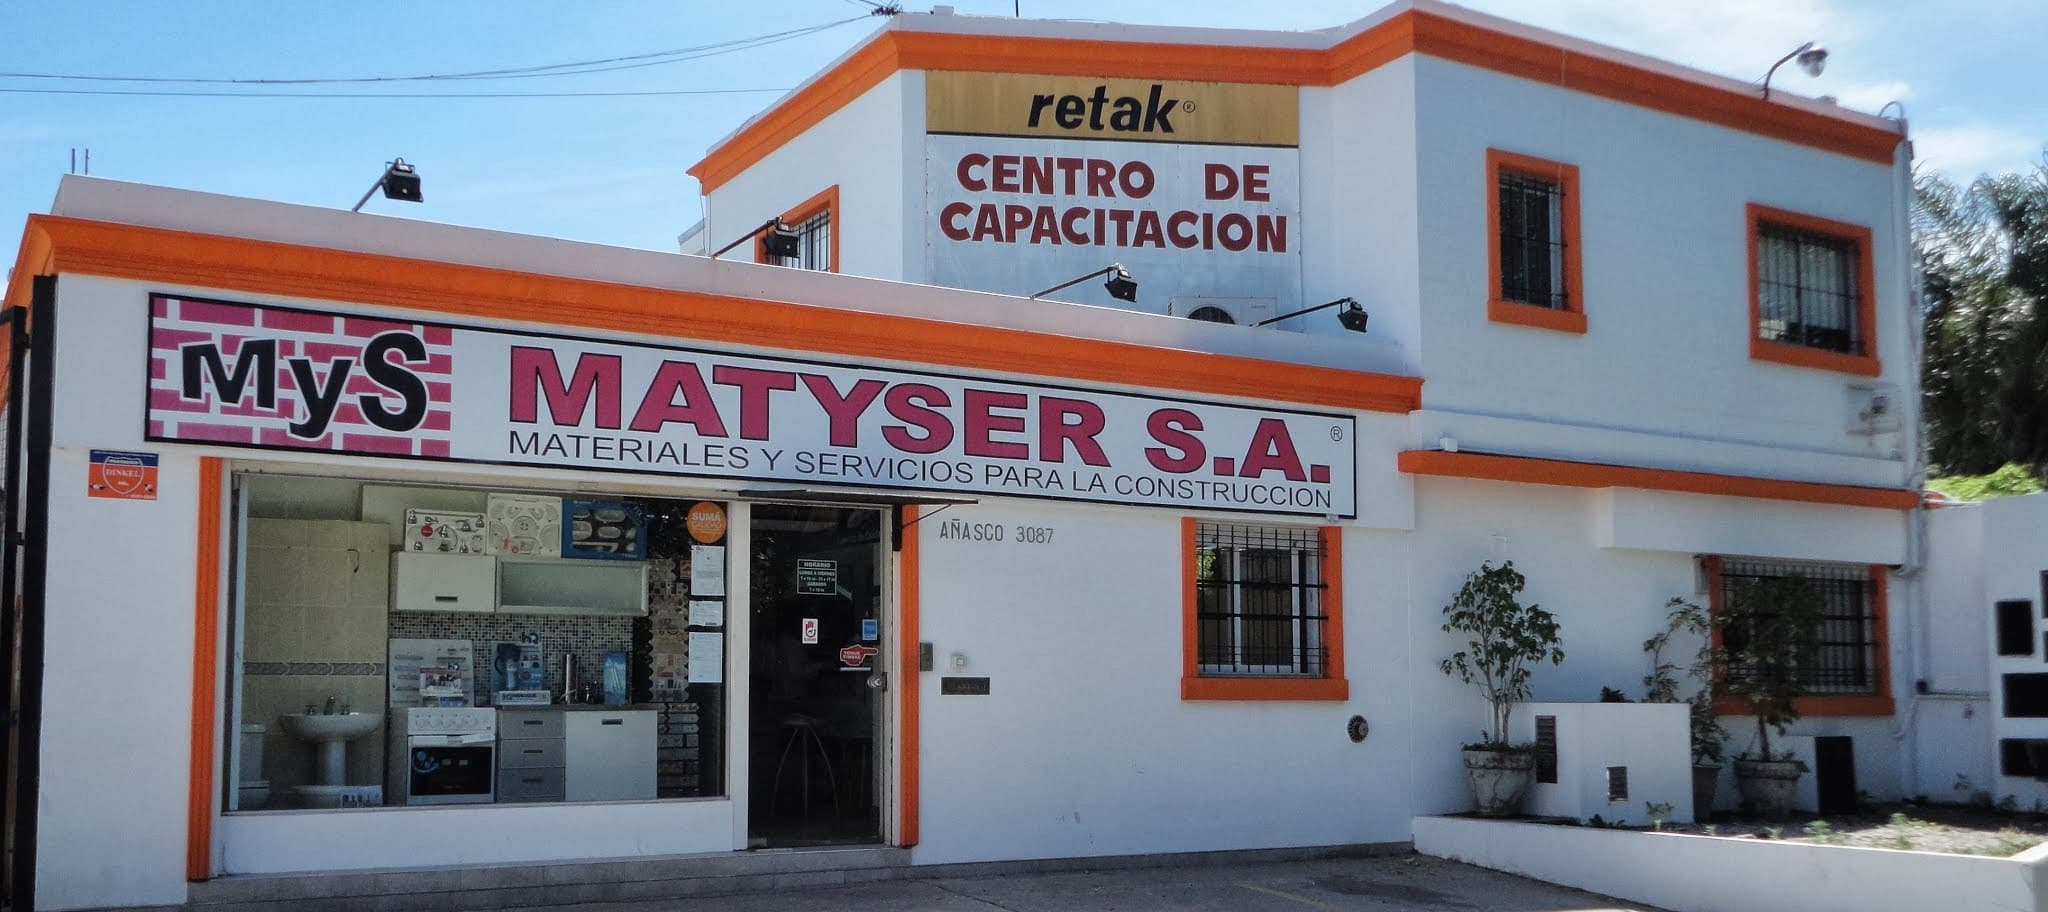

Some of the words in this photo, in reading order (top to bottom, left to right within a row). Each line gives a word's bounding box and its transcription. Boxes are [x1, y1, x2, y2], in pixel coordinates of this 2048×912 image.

[1028, 84, 1179, 134] retak
[957, 153, 1155, 198] CENTRO
[1205, 163, 1270, 201] DE
[940, 202, 1287, 253] CAPACITACION
[181, 331, 428, 438] MyS
[509, 344, 1112, 468] MATYSER
[1144, 407, 1331, 484] S.A.
[509, 430, 750, 469] MATERIALES
[761, 448, 783, 471] Y
[795, 451, 974, 484] SERVICIOS
[985, 464, 1066, 490] PARA
[1072, 470, 1107, 494] LA
[1114, 474, 1332, 509] CONSTRUCCION
[939, 518, 1004, 542] AÑASCO
[1015, 525, 1055, 544] 3087
